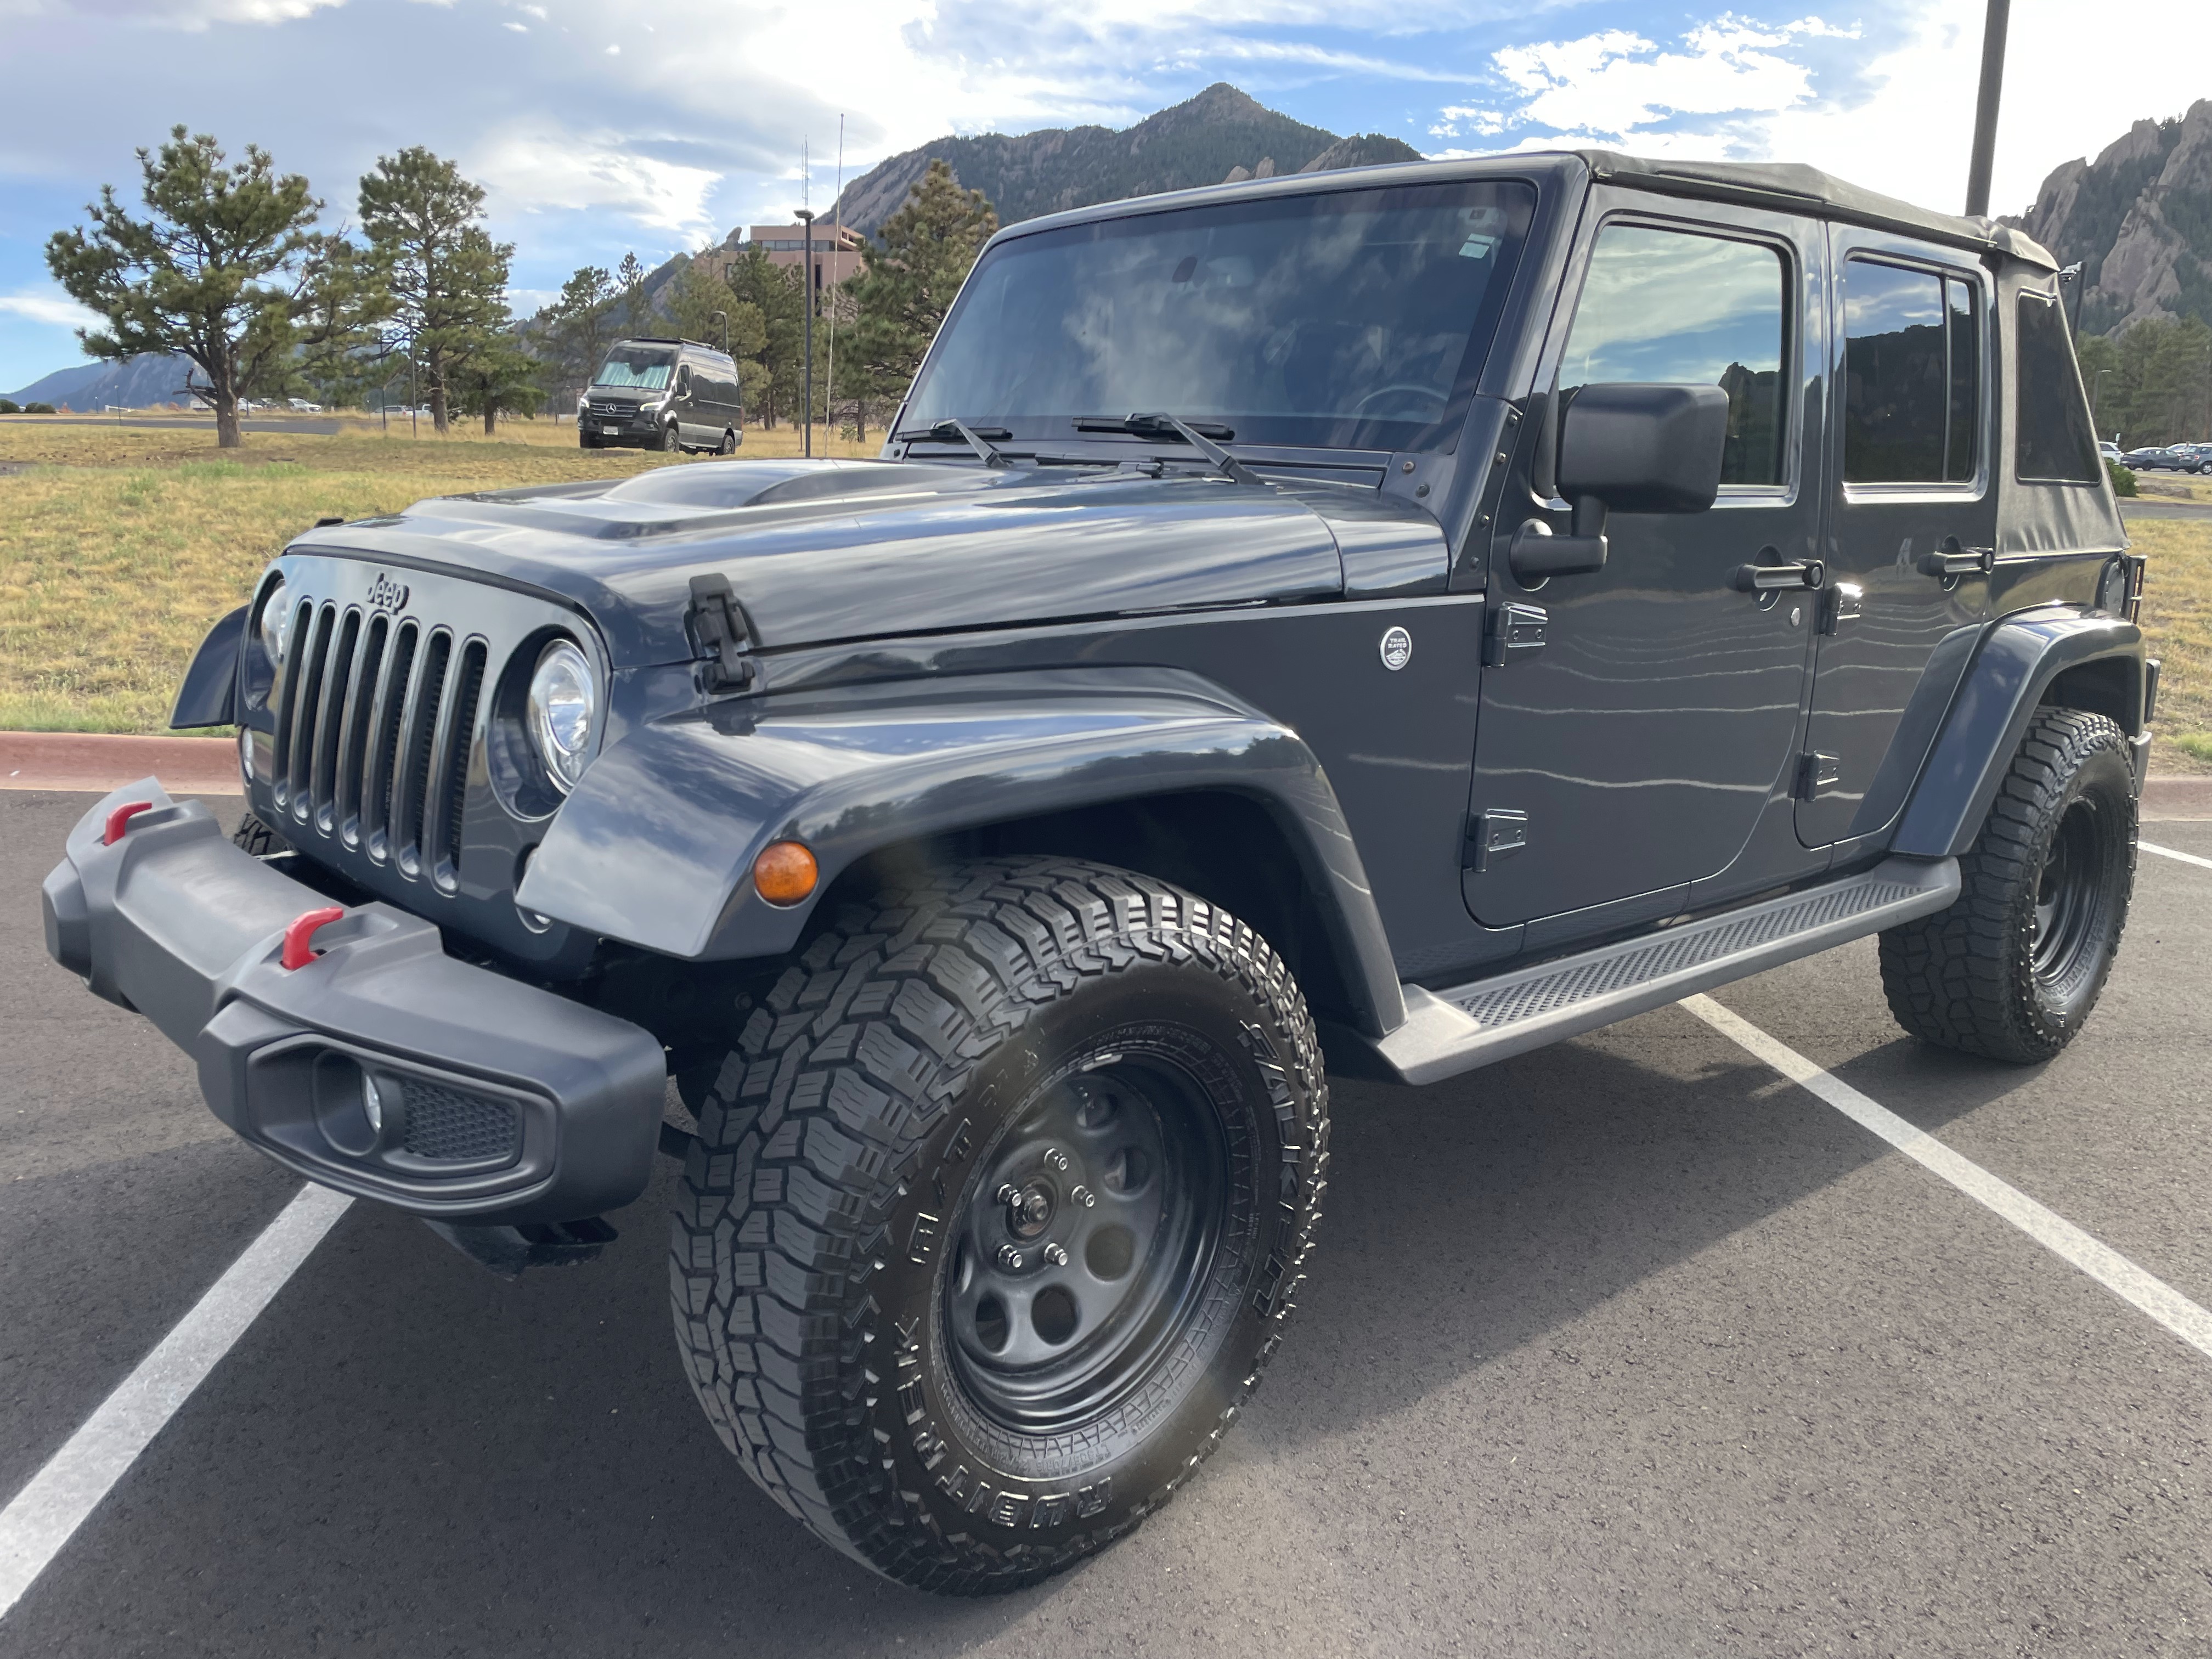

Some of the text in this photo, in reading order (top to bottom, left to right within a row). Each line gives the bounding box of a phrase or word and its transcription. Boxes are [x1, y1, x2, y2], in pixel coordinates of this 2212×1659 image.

[366, 571, 410, 616] Jeep
[1238, 1020, 1301, 1318] FALKEN
[895, 1316, 1112, 1528] RUBITREK
